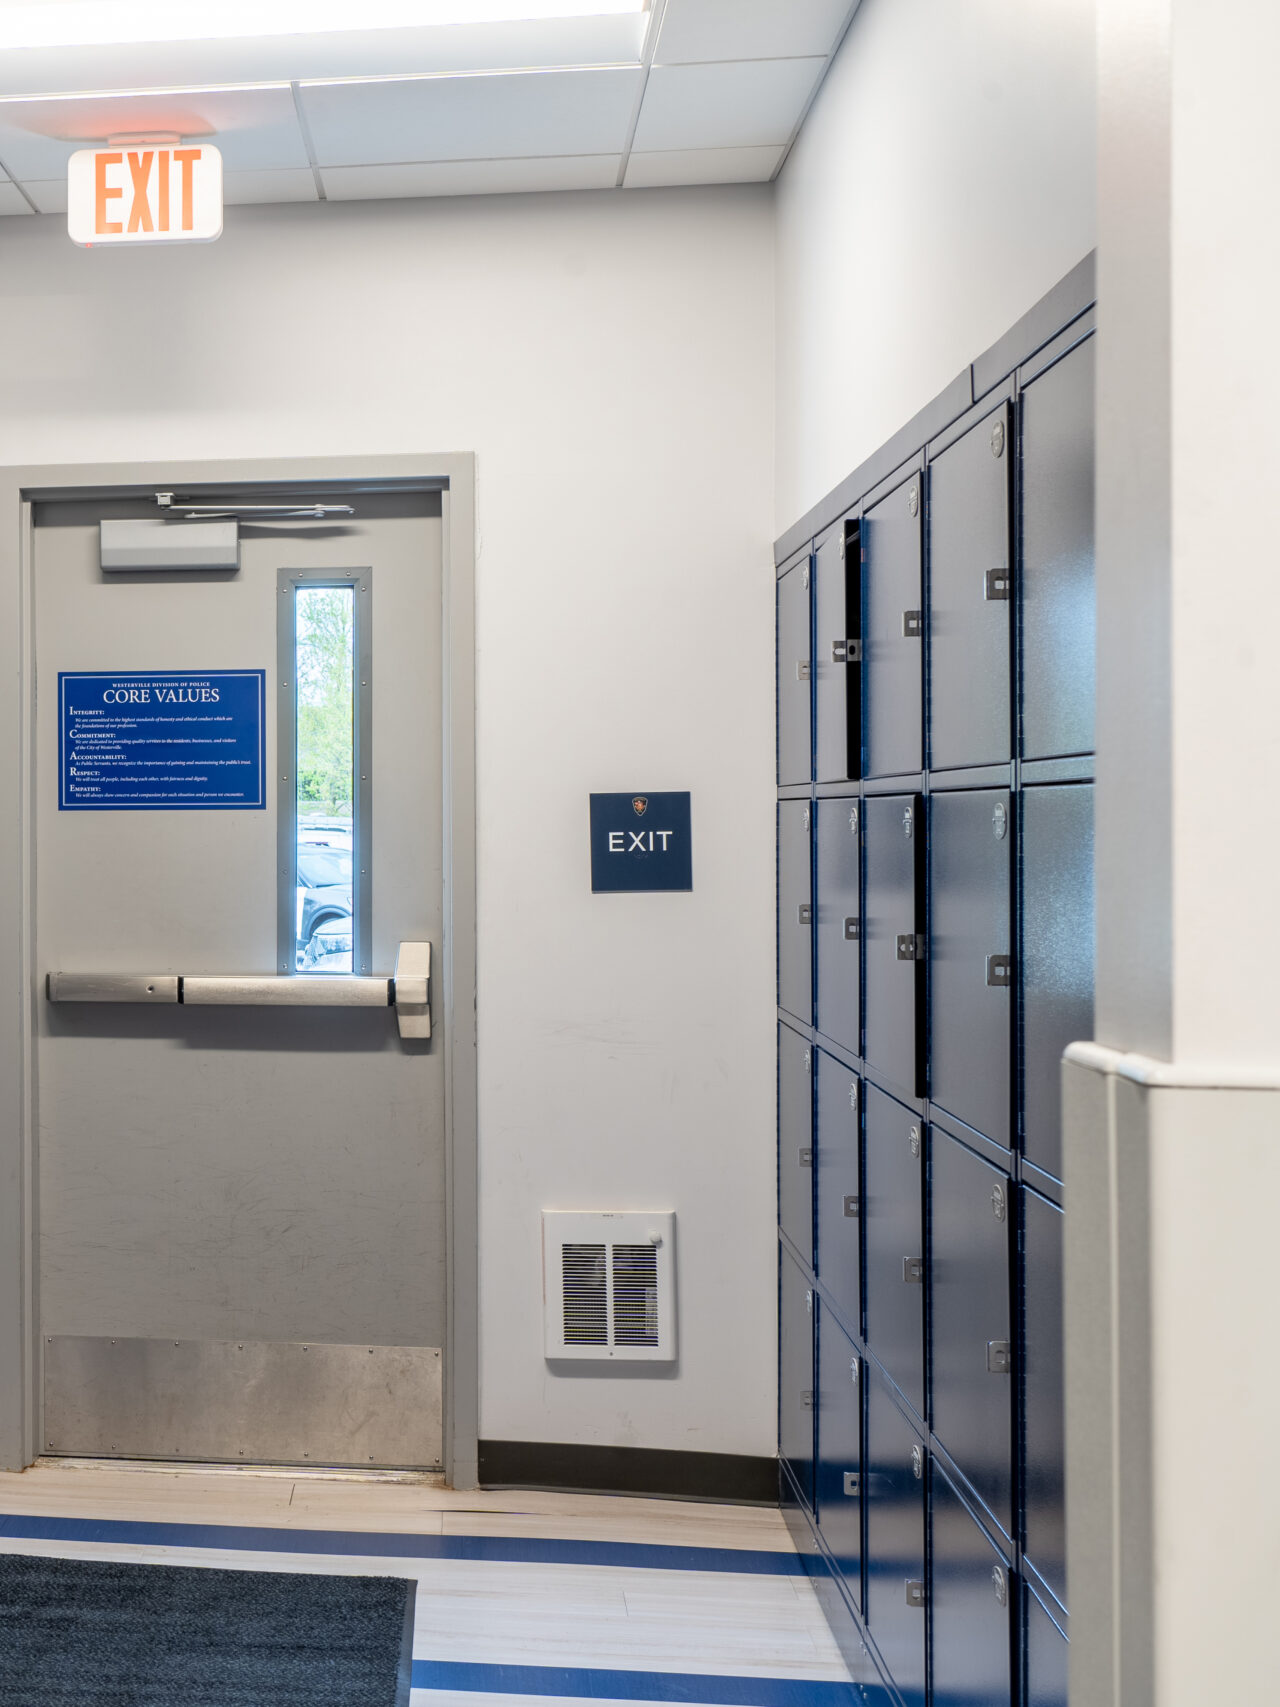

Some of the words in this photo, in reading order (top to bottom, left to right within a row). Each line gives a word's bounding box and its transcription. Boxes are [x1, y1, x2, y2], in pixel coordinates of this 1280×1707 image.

[95, 149, 201, 235] EXIT
[103, 689, 151, 704] CORE
[154, 688, 220, 703] VALUES
[69, 706, 105, 715] INTEGRITY:
[69, 729, 116, 738] COMMITMENT:
[70, 752, 127, 760] ACCOUNTABILITY:
[70, 767, 100, 776] RESPECT:
[608, 831, 673, 852] EXIT
